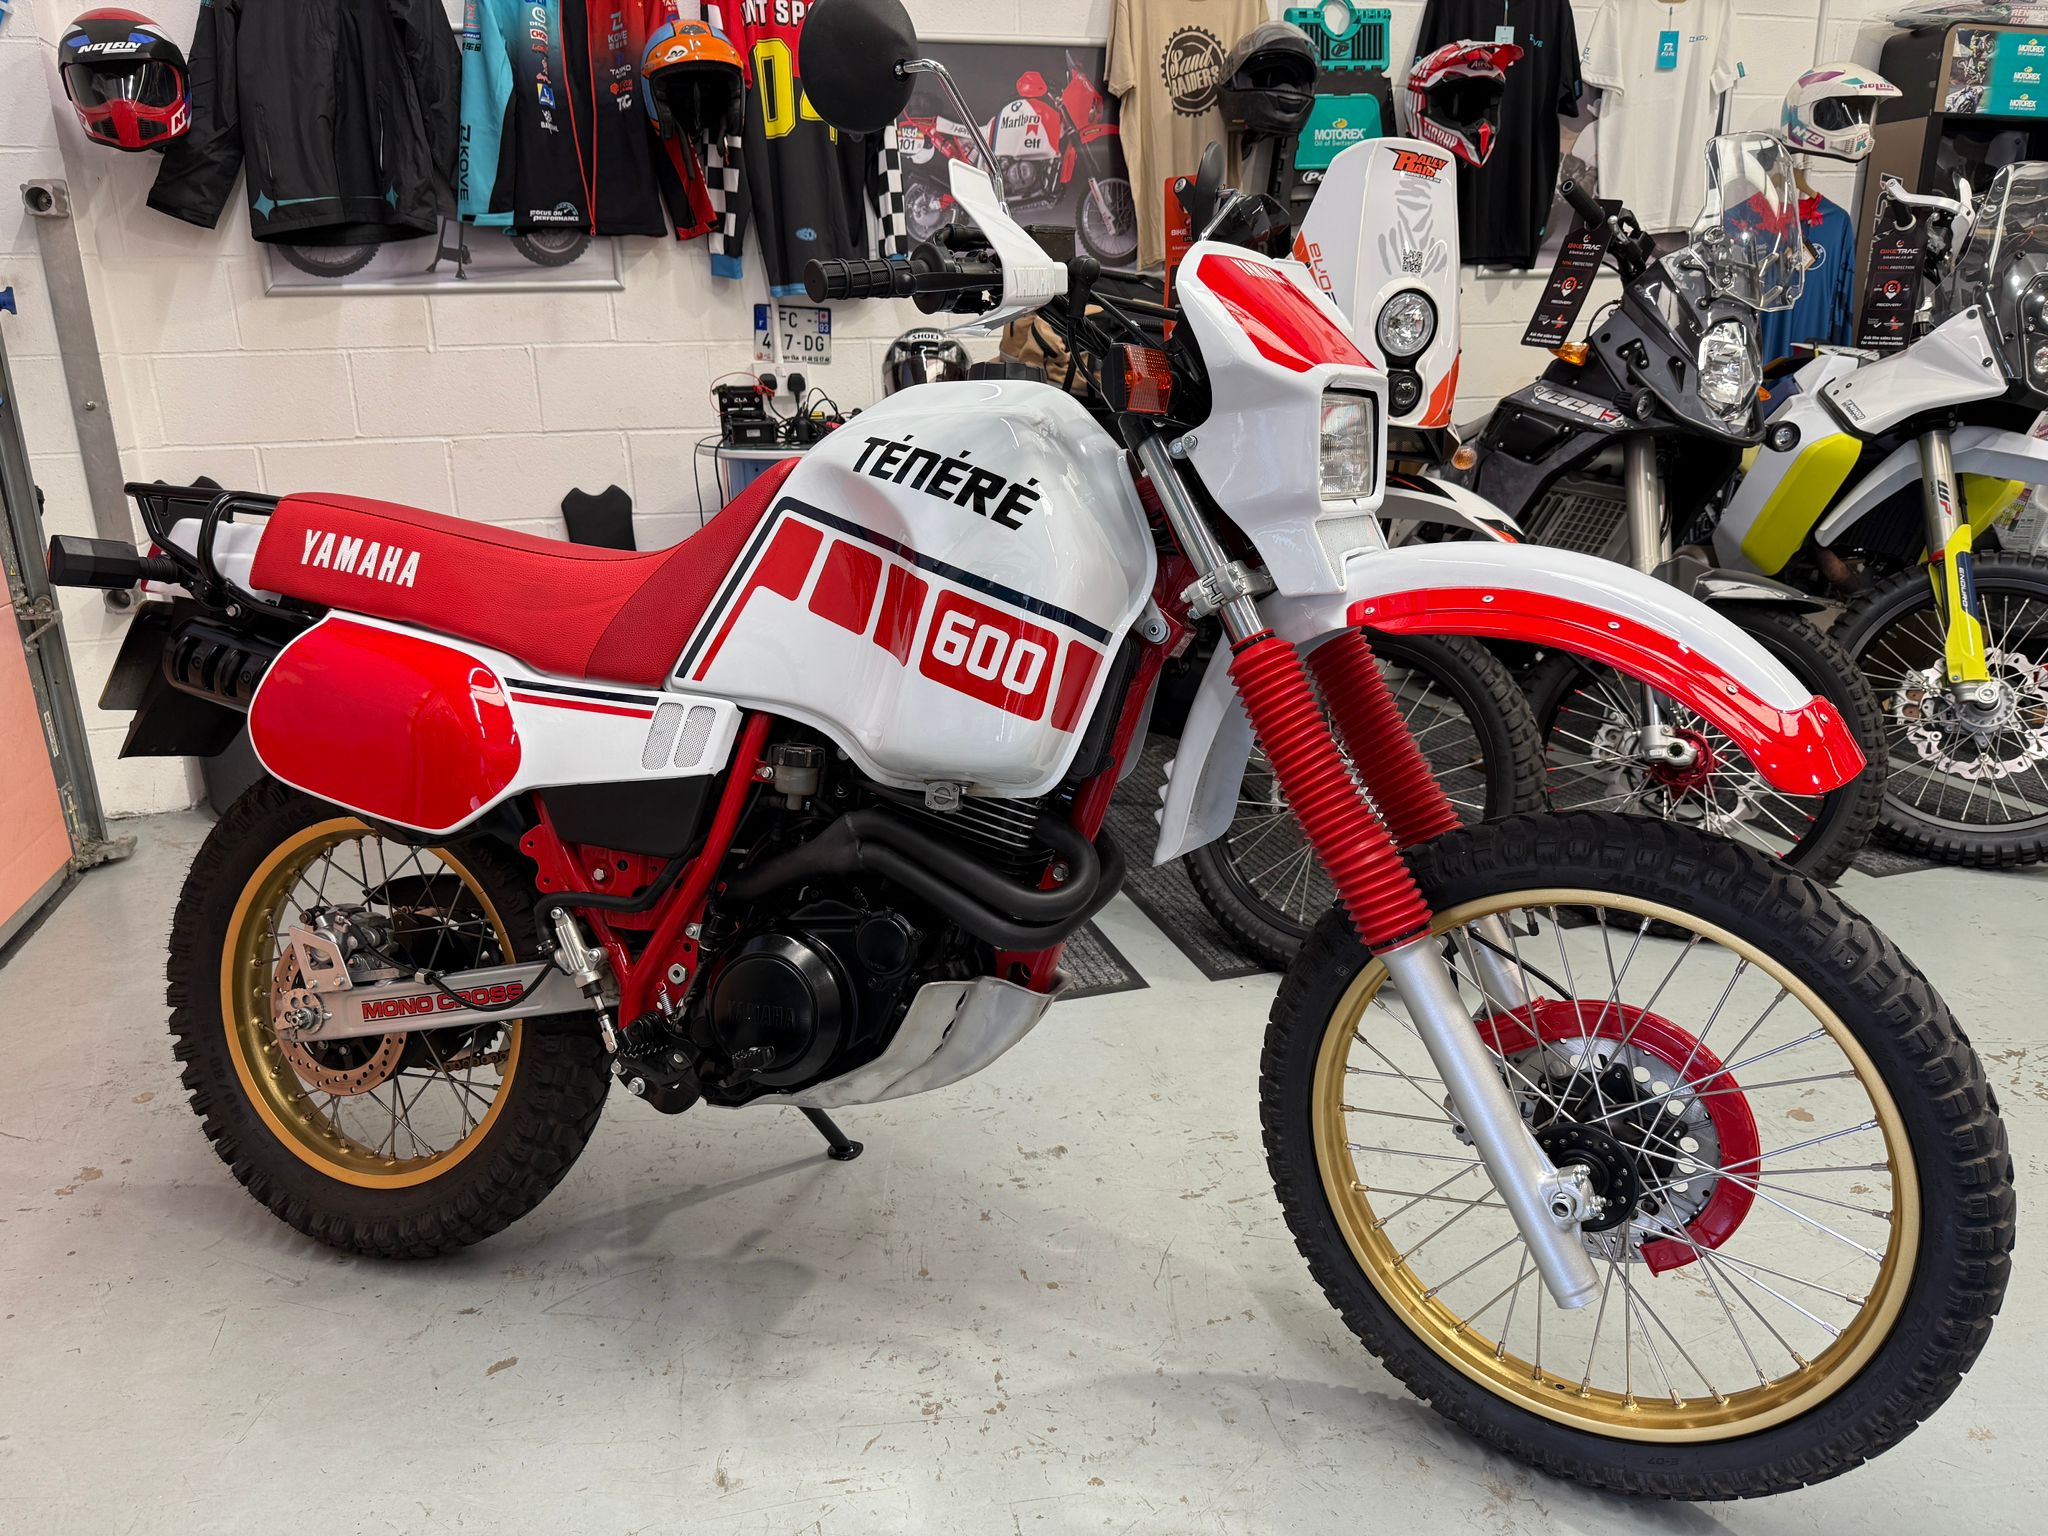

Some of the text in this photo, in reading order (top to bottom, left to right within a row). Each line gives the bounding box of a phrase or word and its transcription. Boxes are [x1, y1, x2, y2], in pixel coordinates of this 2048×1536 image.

[78, 42, 141, 55] NOLAN
[1170, 46, 1215, 78] Sand
[1172, 65, 1220, 97] RAIDERS
[1001, 115, 1041, 130] Marlboro
[1314, 128, 1364, 140] MOTOREX
[899, 139, 915, 151] 101
[1024, 138, 1041, 149] elf
[460, 146, 469, 201] KOVE
[1568, 243, 1601, 251] BIKETRAC
[1537, 391, 1607, 419] CCM
[301, 529, 421, 588] YAMAHA
[932, 609, 1048, 696] 600
[362, 983, 525, 1020] MONO CROSS
